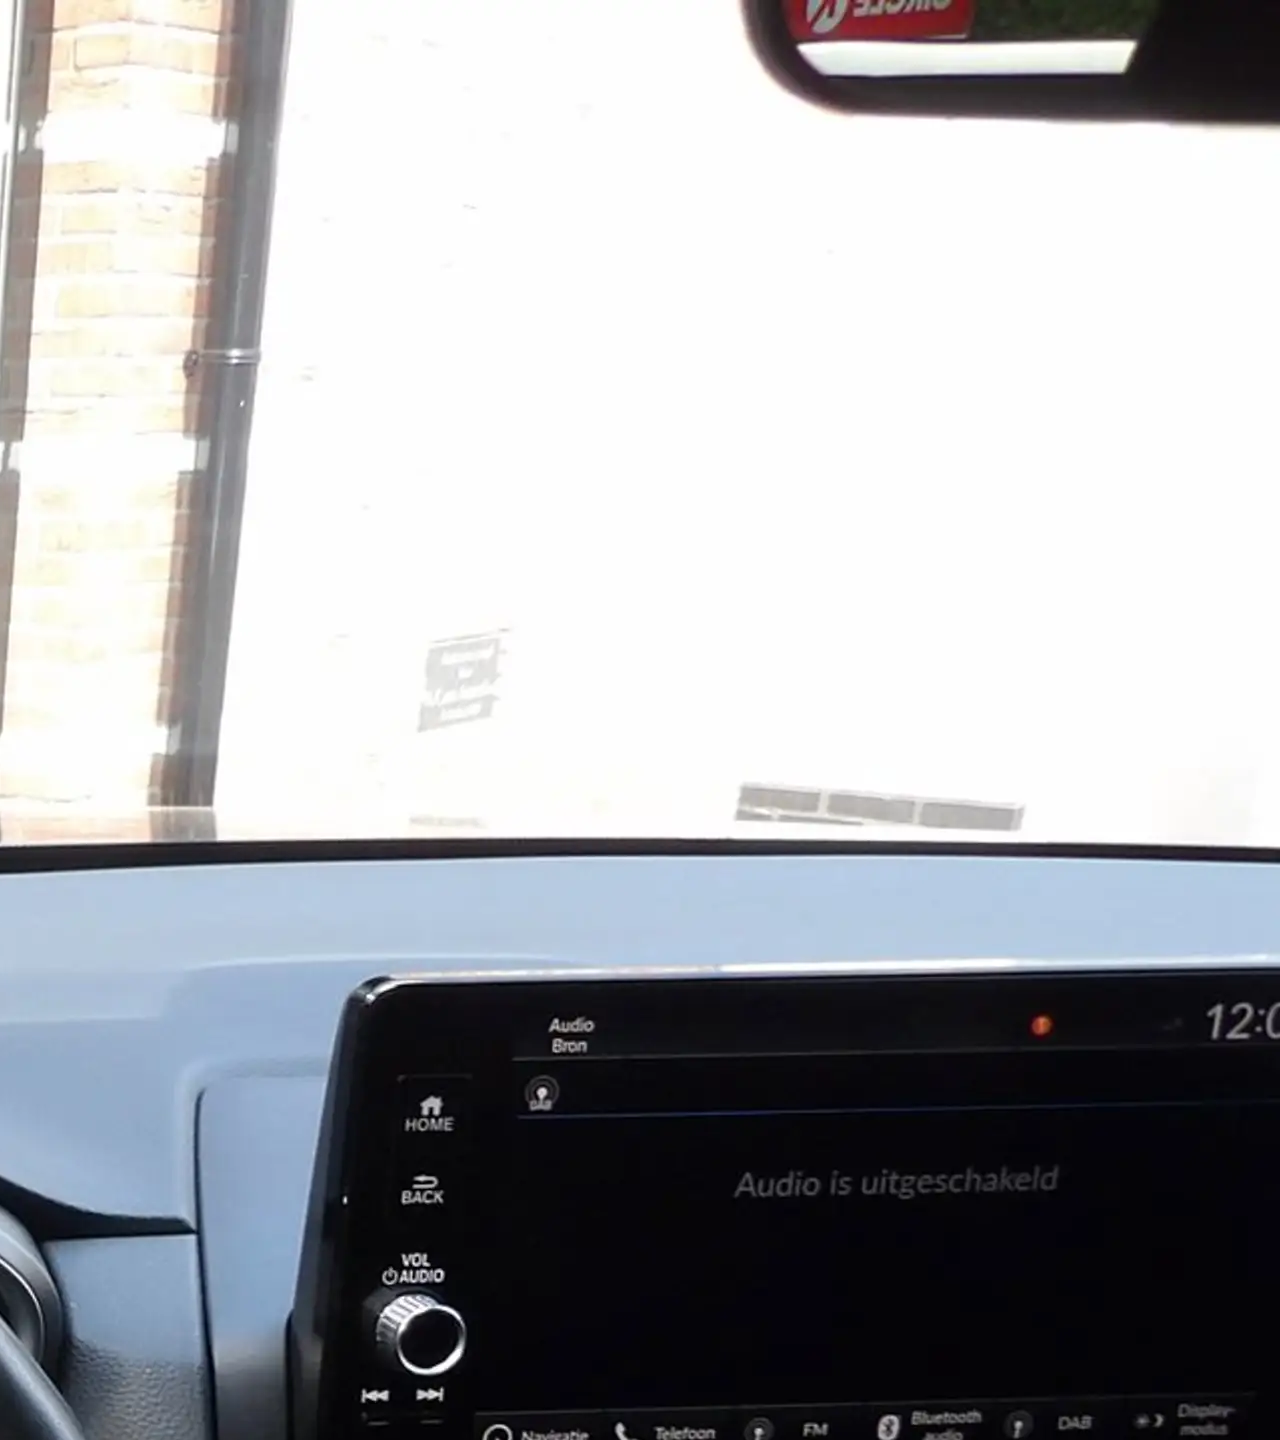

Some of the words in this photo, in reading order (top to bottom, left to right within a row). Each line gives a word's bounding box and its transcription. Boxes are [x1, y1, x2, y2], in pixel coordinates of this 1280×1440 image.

[548, 1017, 596, 1033] Audio
[551, 1037, 588, 1054] Bron
[404, 1113, 454, 1132] HOME
[733, 1170, 822, 1198] Audio
[829, 1169, 853, 1196] is
[861, 1165, 1059, 1200] uitgeschakeld
[400, 1186, 444, 1205] BACK
[401, 1252, 431, 1268] VOL
[398, 1265, 445, 1284] AUDIO
[910, 1409, 982, 1426] Bluetooth
[1057, 1415, 1093, 1431] DAB
[802, 1422, 829, 1437] FM
